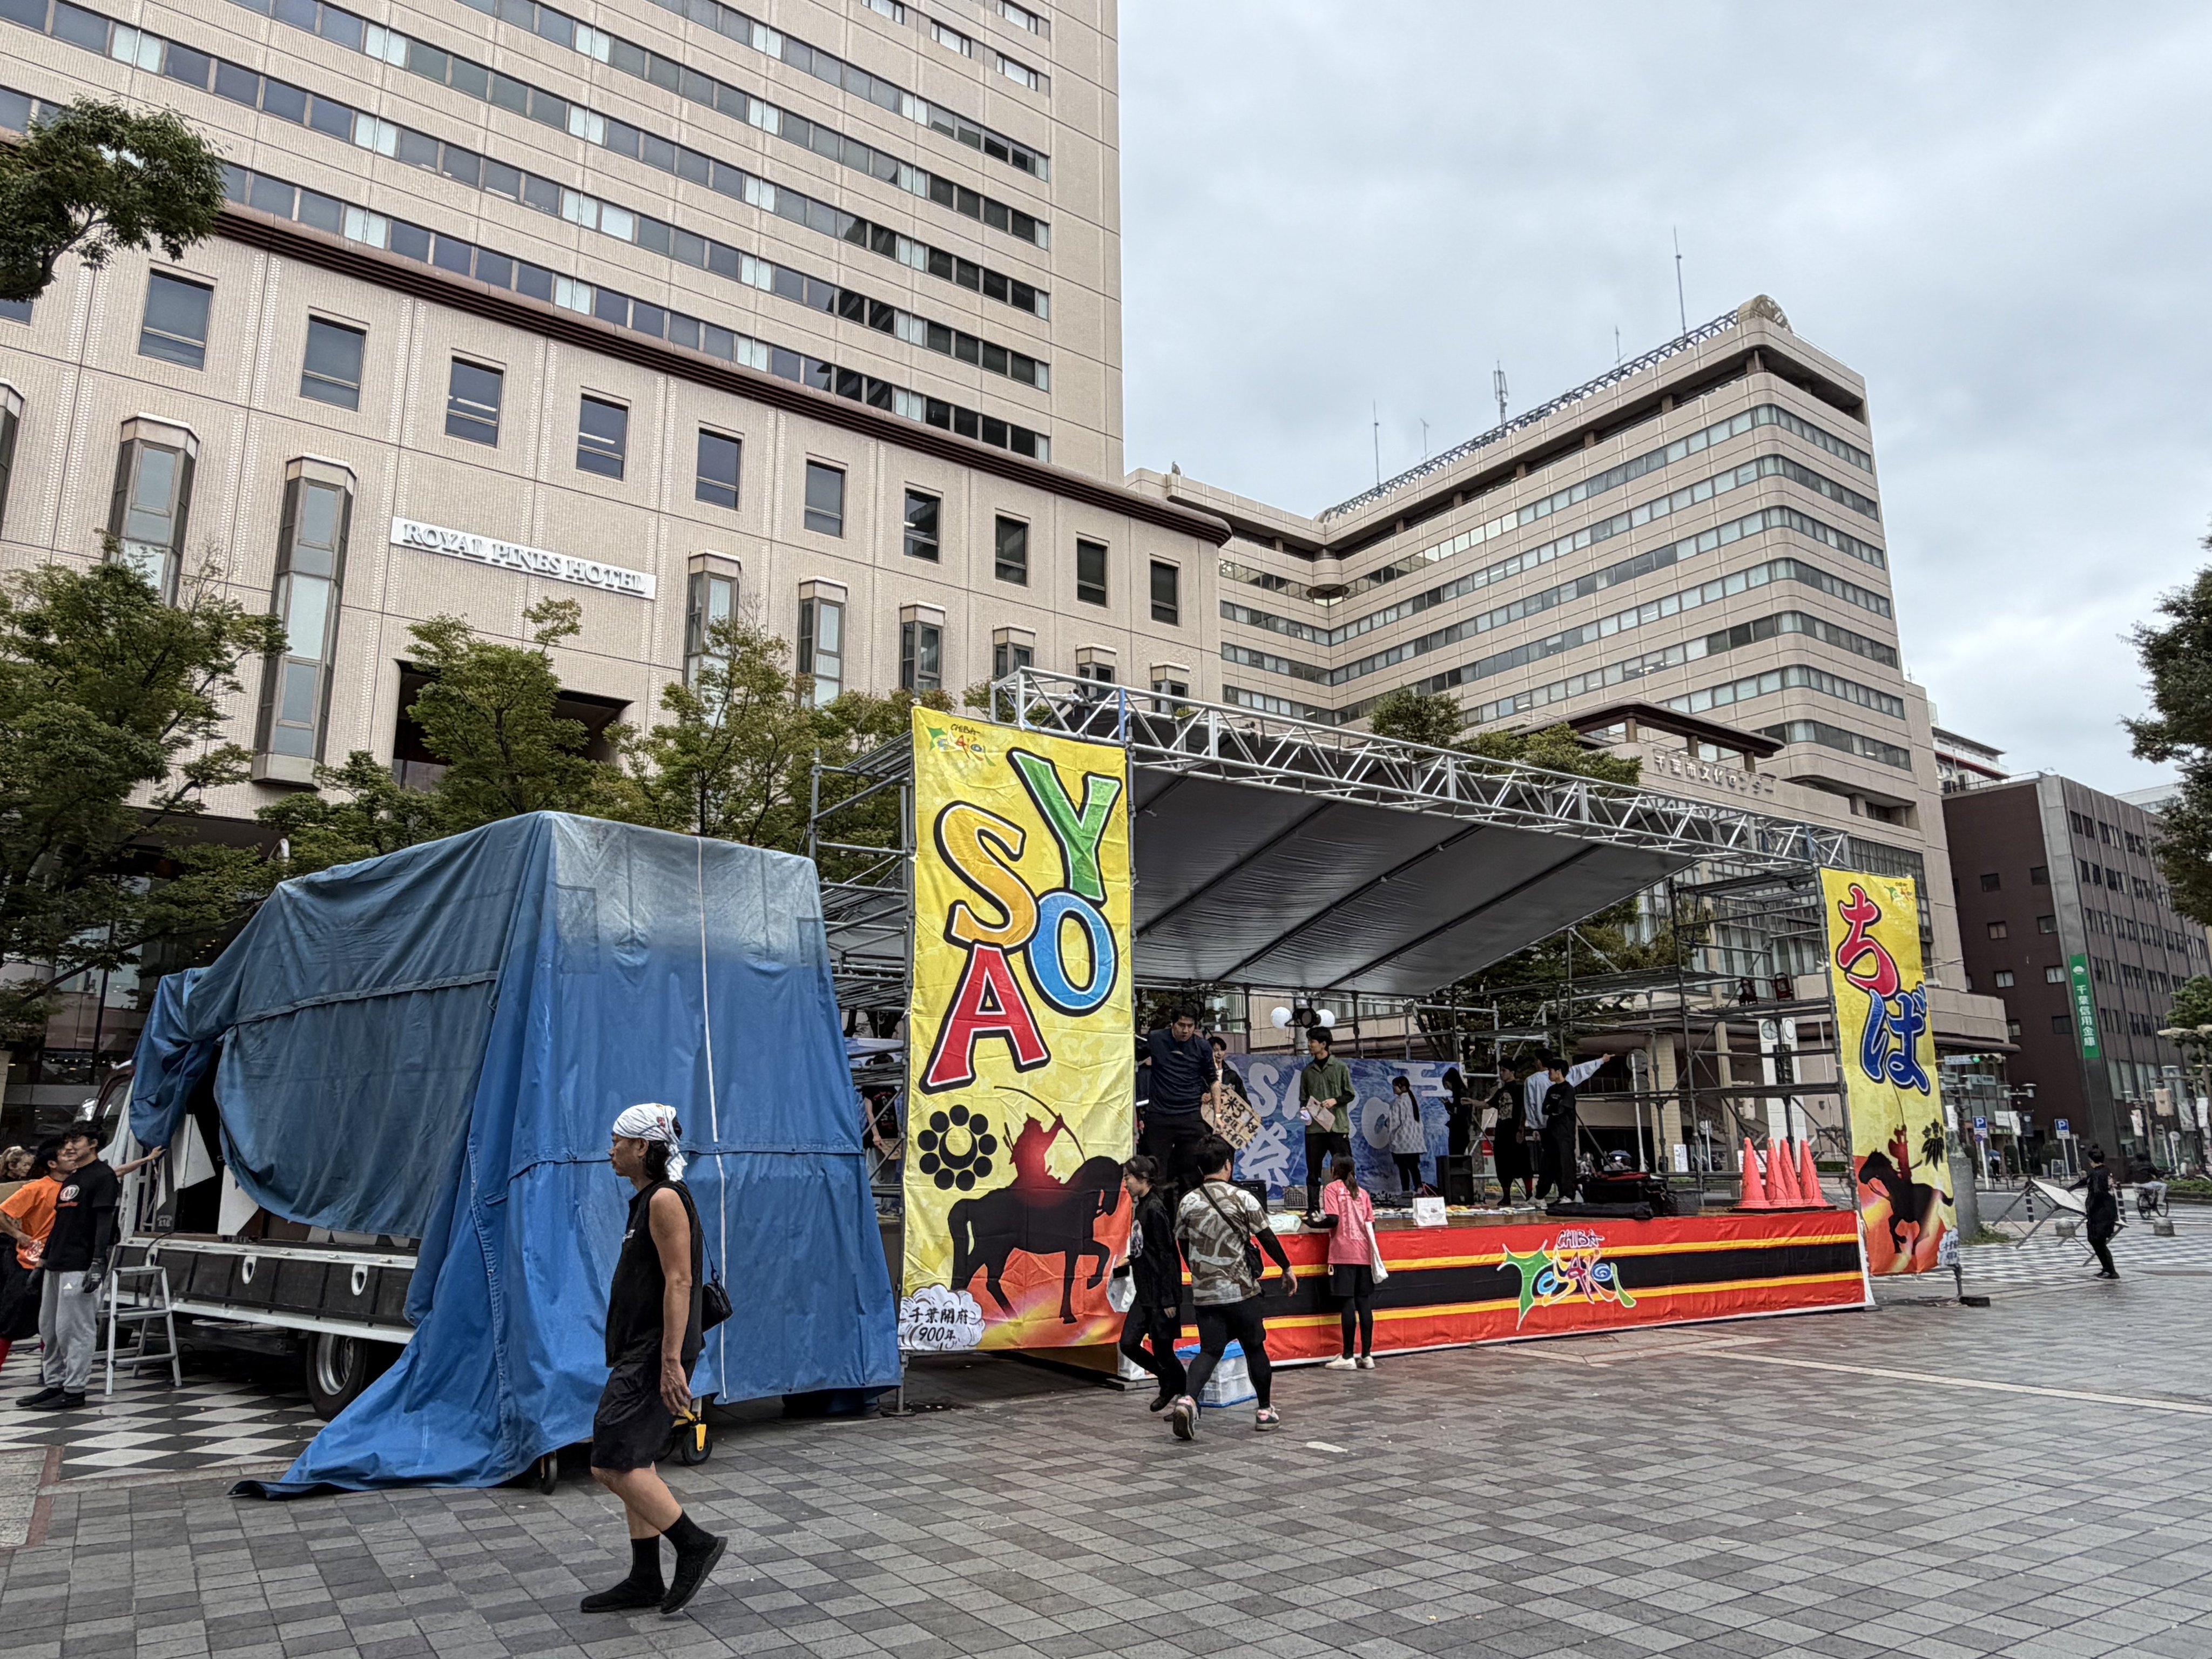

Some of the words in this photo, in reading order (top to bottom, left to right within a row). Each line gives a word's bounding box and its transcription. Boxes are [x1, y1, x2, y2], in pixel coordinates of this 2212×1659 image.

[403, 523, 488, 558] ROYAL
[491, 544, 563, 576] PINES
[565, 560, 646, 594] HOTEL
[950, 724, 981, 735] CHIBA
[1655, 755, 1773, 793] 千葉市文化センター
[1836, 882, 1931, 1096] ちば
[2076, 984, 2095, 1047] 千葉信用金庫
[1975, 1117, 1984, 1127] P
[2058, 1121, 2066, 1129] P
[1556, 1229, 1605, 1248] CHIBA
[919, 1326, 956, 1342] 900年
